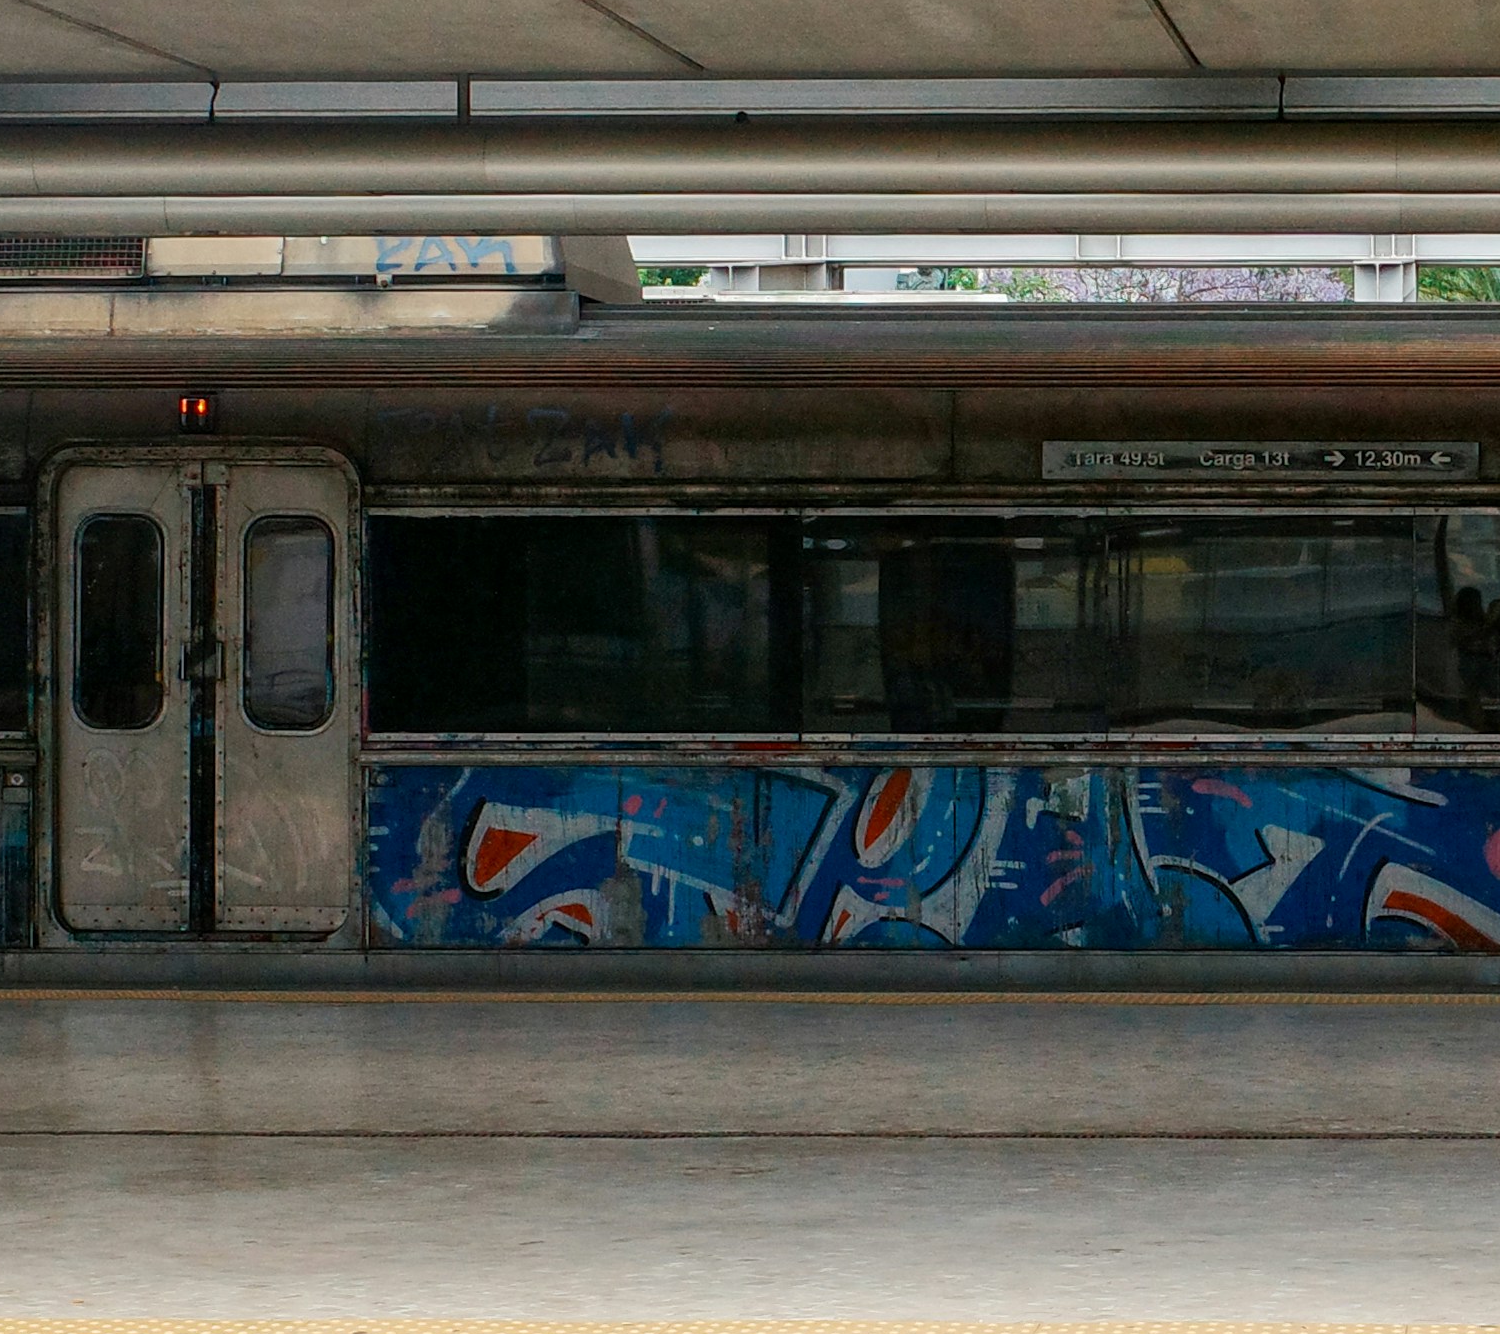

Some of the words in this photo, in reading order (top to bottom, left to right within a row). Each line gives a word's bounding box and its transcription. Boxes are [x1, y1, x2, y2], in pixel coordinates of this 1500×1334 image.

[1074, 451, 1114, 467] Tara
[1119, 451, 1165, 469] 49,5t
[1199, 451, 1256, 471] Carga
[1261, 451, 1290, 467] 13t
[1354, 451, 1422, 470] 12,30m
